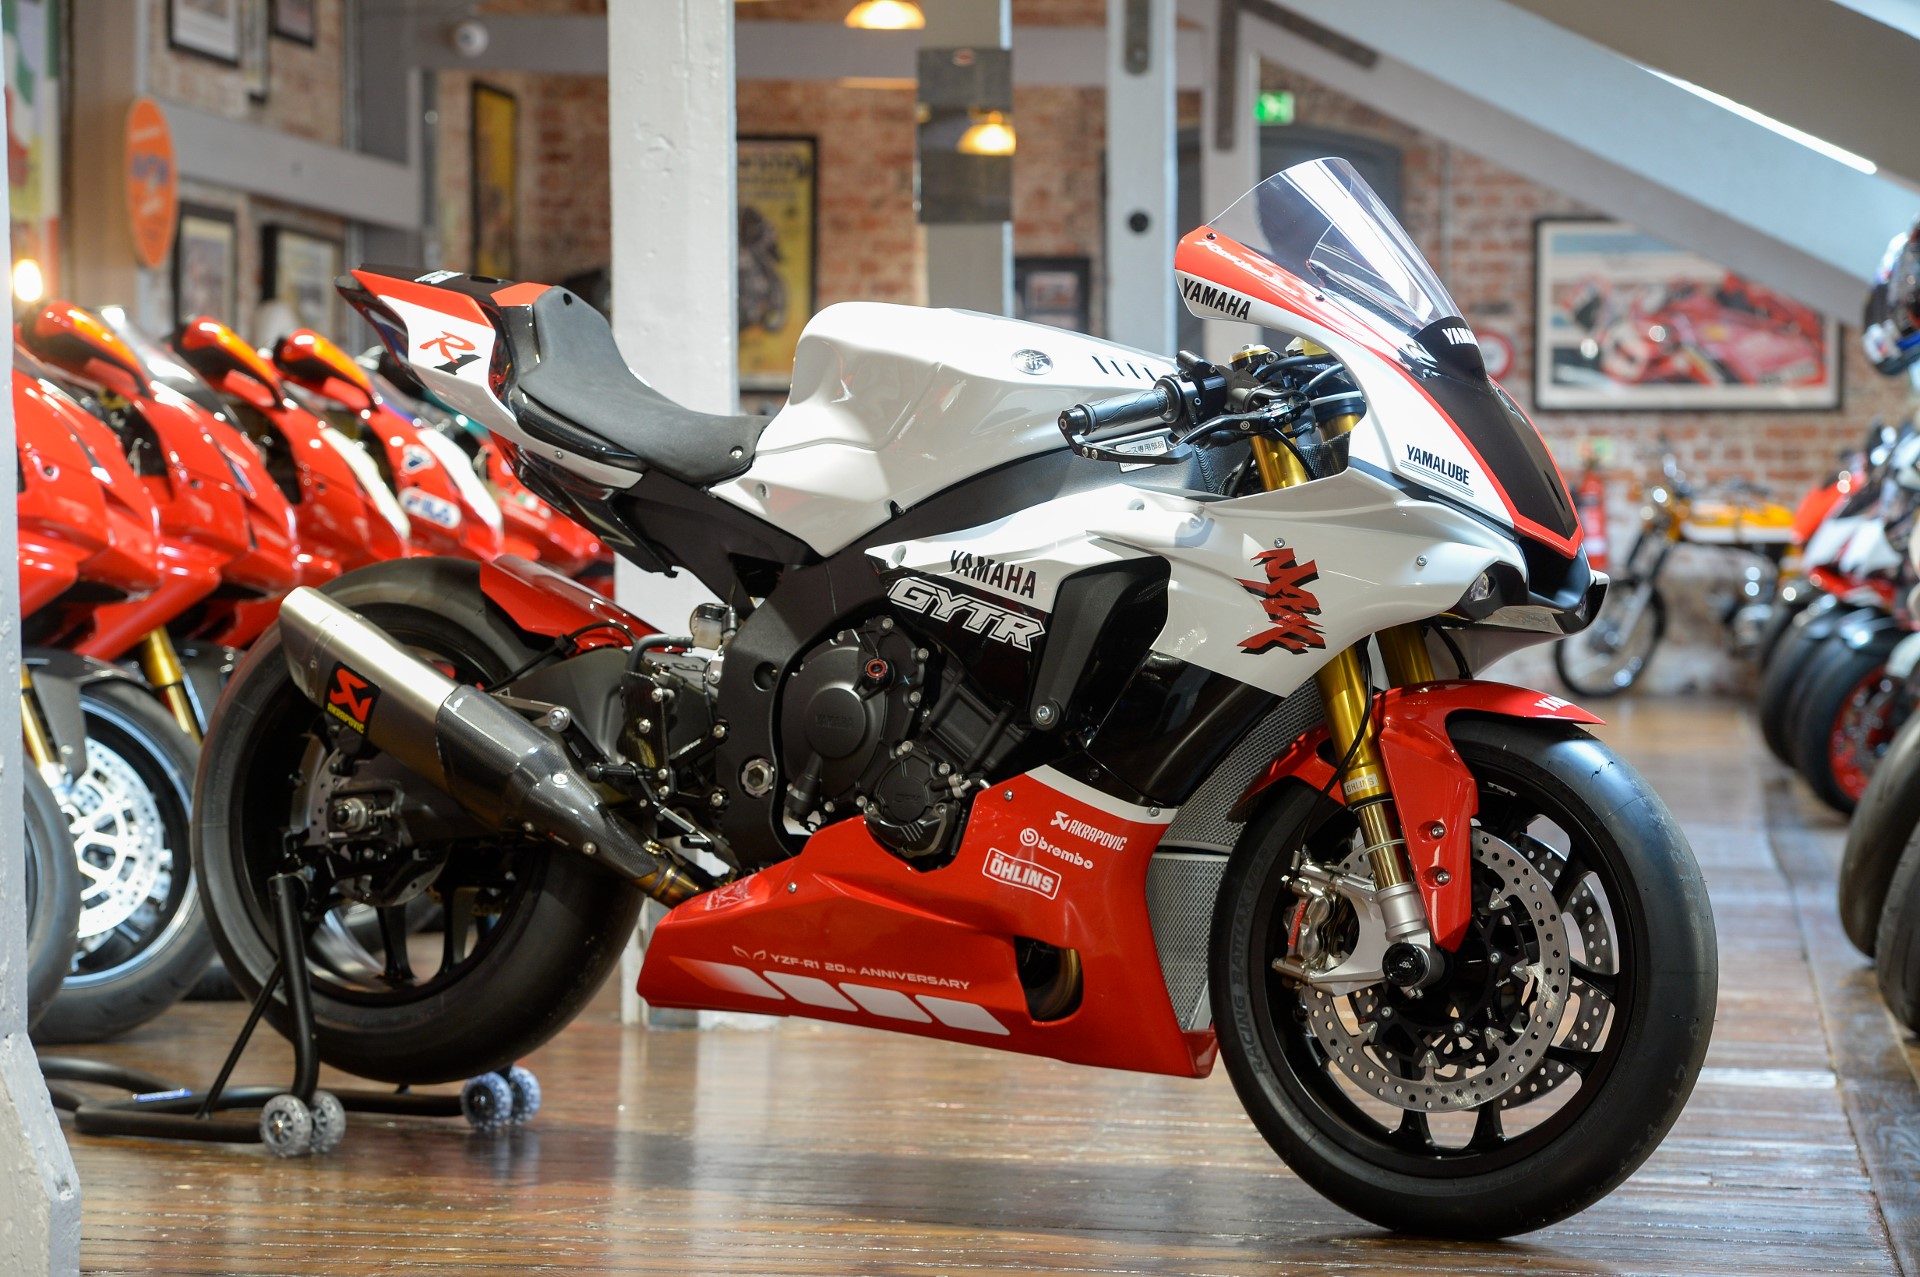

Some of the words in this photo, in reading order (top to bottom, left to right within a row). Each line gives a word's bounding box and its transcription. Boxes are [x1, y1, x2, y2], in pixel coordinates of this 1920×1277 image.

[1183, 277, 1252, 321] YAMAHA
[1406, 443, 1470, 486] YAMALUBE
[950, 549, 1037, 600] YAMAHA
[886, 576, 1047, 653] GYTR
[989, 852, 1055, 893] ÖHLINS
[1037, 836, 1095, 870] brembo
[770, 953, 820, 970] YZF-R1
[859, 966, 970, 991] ANNIVERSARY
